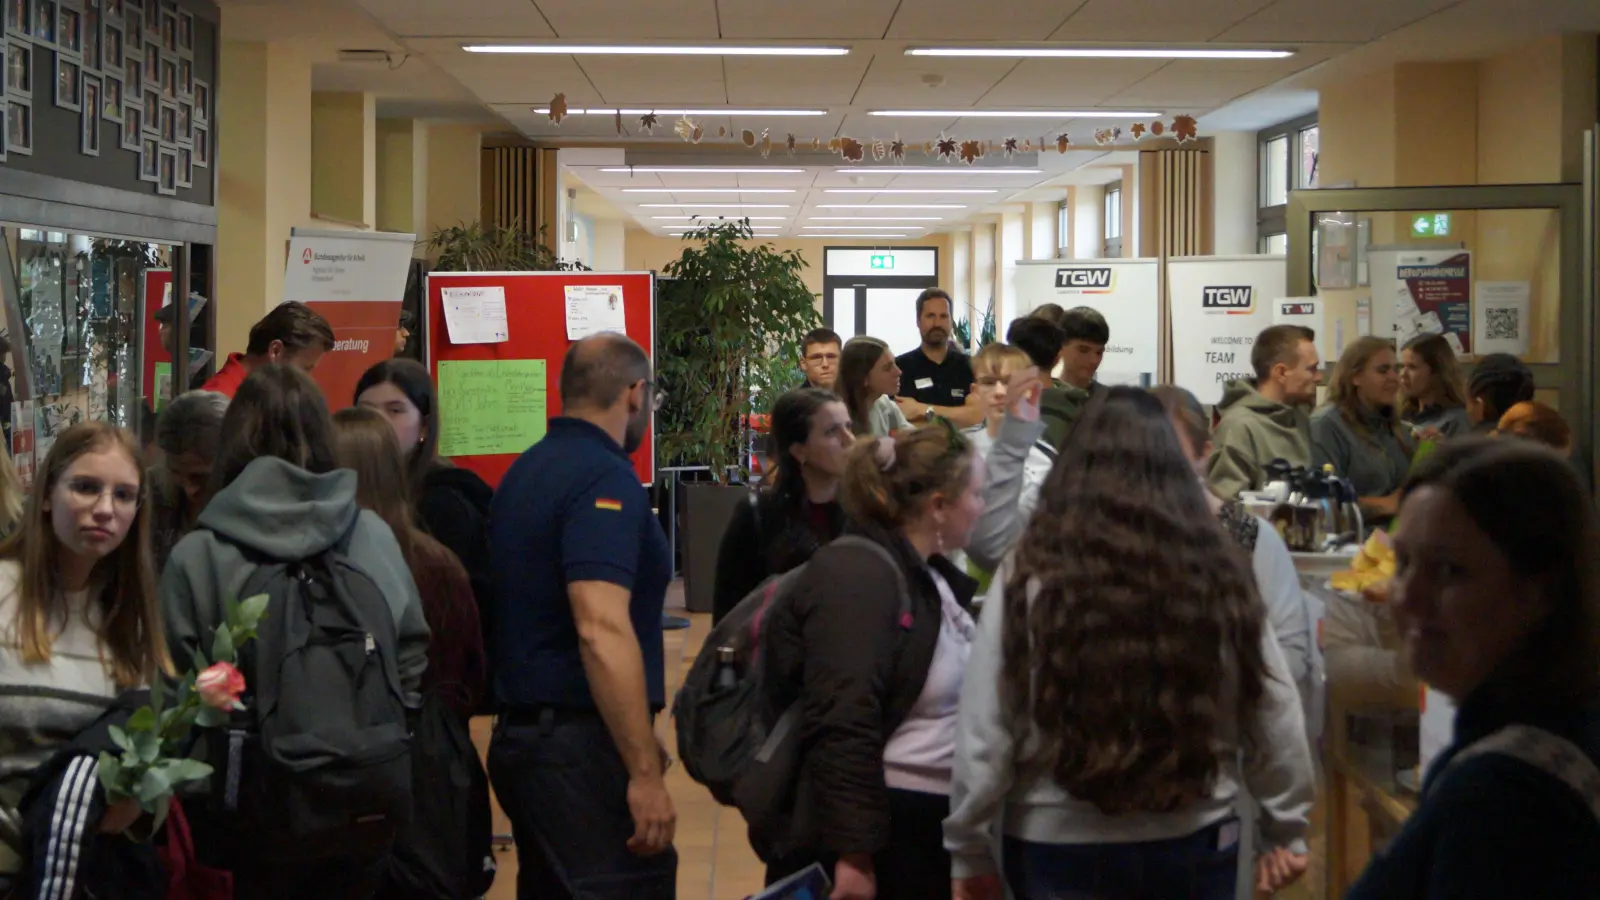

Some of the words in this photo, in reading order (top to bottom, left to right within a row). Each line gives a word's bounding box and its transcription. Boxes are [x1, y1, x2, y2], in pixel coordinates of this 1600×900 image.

[1058, 270, 1109, 285] TGW
[1205, 288, 1250, 304] TGW
[1211, 336, 1242, 345] WELCOME
[1244, 337, 1253, 345] TO
[1104, 343, 1134, 355] bildung
[1205, 352, 1235, 364] TEAM
